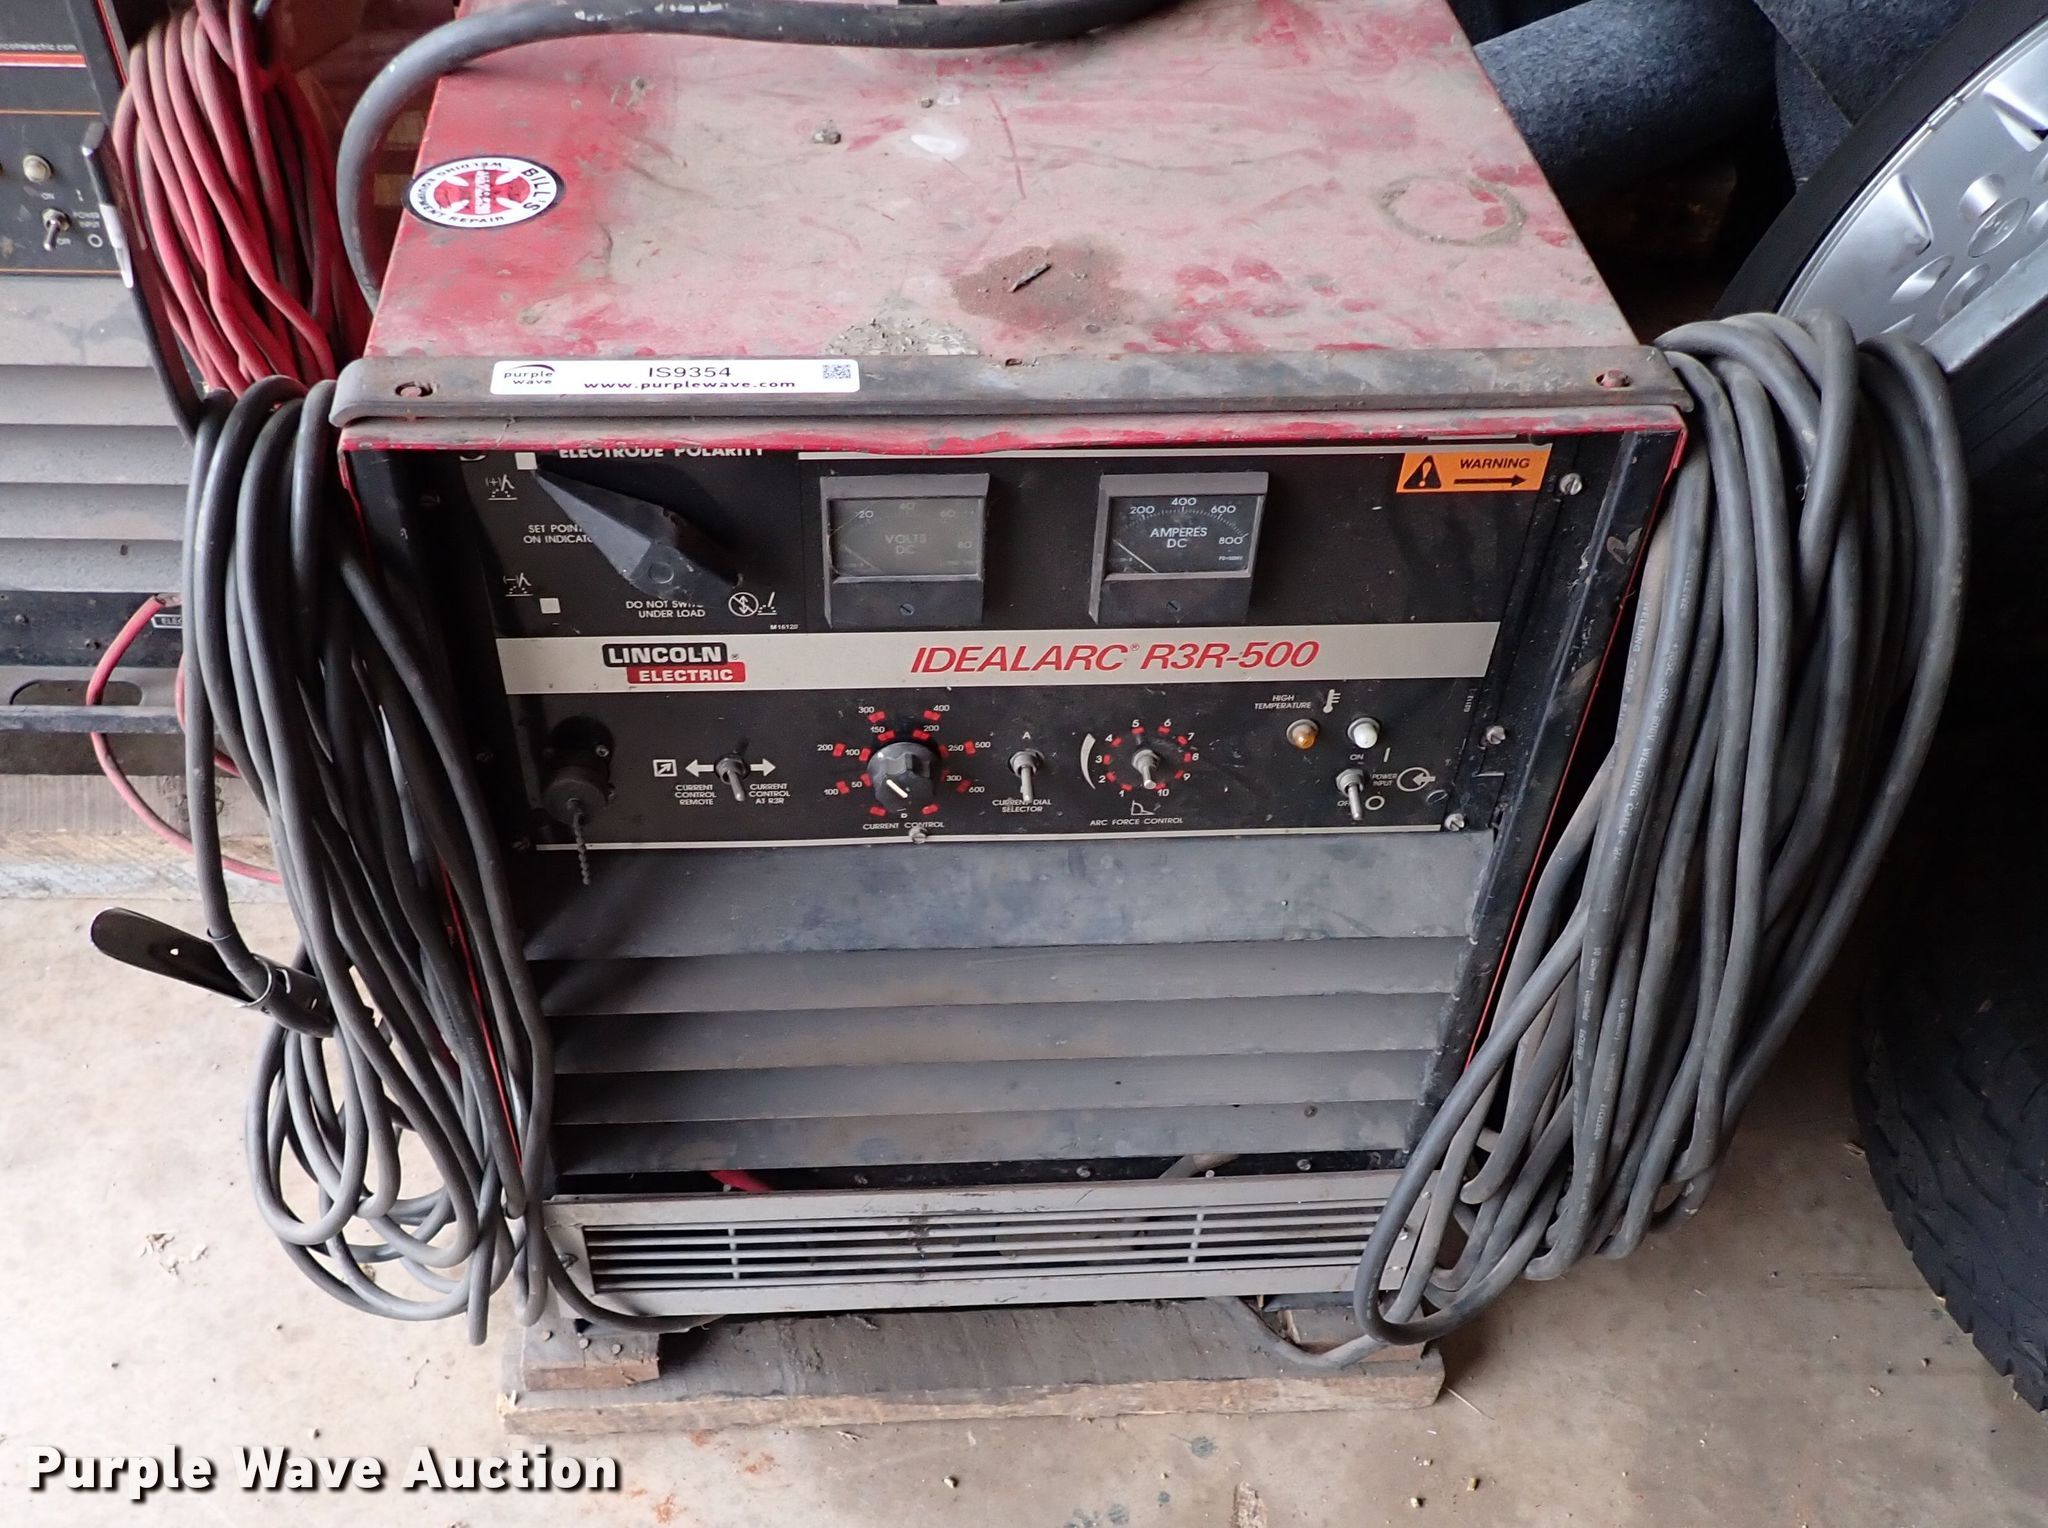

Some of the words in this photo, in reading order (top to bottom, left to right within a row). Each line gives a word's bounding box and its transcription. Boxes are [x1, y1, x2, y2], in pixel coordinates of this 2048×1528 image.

[503, 371, 553, 379] purple
[648, 367, 732, 378] IS9354
[584, 381, 796, 390] www.purplewave.com
[1459, 457, 1531, 469] WARNING
[1171, 497, 1197, 506] 400
[1130, 505, 1155, 515] 200
[1210, 505, 1236, 514] 600
[528, 524, 546, 533] SET
[1150, 526, 1208, 538] AMPERES
[523, 535, 541, 544] ON
[544, 534, 593, 544] INDICAT
[884, 533, 927, 544] VOLTS
[1218, 536, 1244, 545] 800
[1166, 538, 1188, 549] DC
[895, 544, 916, 555] DC
[625, 600, 643, 609] DO
[645, 600, 669, 609] NOT
[638, 609, 674, 618] UNDER
[676, 609, 706, 618] LOAD
[608, 646, 723, 664] LINCOLN
[1140, 640, 1321, 670] R3R-500
[638, 669, 734, 682] ELECTRIC
[1272, 694, 1295, 702] HIGH
[858, 706, 875, 714] 300
[932, 704, 950, 712] 400
[1254, 701, 1312, 710] TEMPERATURE
[1132, 719, 1140, 728] 5
[1163, 718, 1172, 727] 6
[870, 725, 886, 734] 150
[923, 724, 940, 732] 200
[1022, 731, 1031, 740] A
[1105, 734, 1113, 743] 4
[1187, 732, 1195, 741] 7
[816, 743, 834, 752] 200
[947, 744, 965, 752] 250
[974, 741, 991, 749] 500
[845, 748, 861, 757] 100
[1191, 752, 1200, 761] 8
[1095, 754, 1103, 763] 3
[1182, 772, 1191, 782] 9
[1629, 747, 1652, 798] WELDING
[946, 774, 962, 783] 300
[1098, 774, 1106, 784] 2
[748, 790, 791, 798] CONTROL
[823, 788, 839, 796] 100
[968, 786, 985, 794] 600
[1118, 789, 1125, 797] 1
[1157, 788, 1170, 797] 10
[1032, 798, 1052, 806] DIAL
[1001, 805, 1043, 813] SELECTOR
[863, 822, 900, 830] CURRENT
[904, 821, 945, 830] CONTROL
[1090, 818, 1108, 826] ARC
[1112, 817, 1140, 826] FORCE
[1143, 816, 1184, 825] CONTROL
